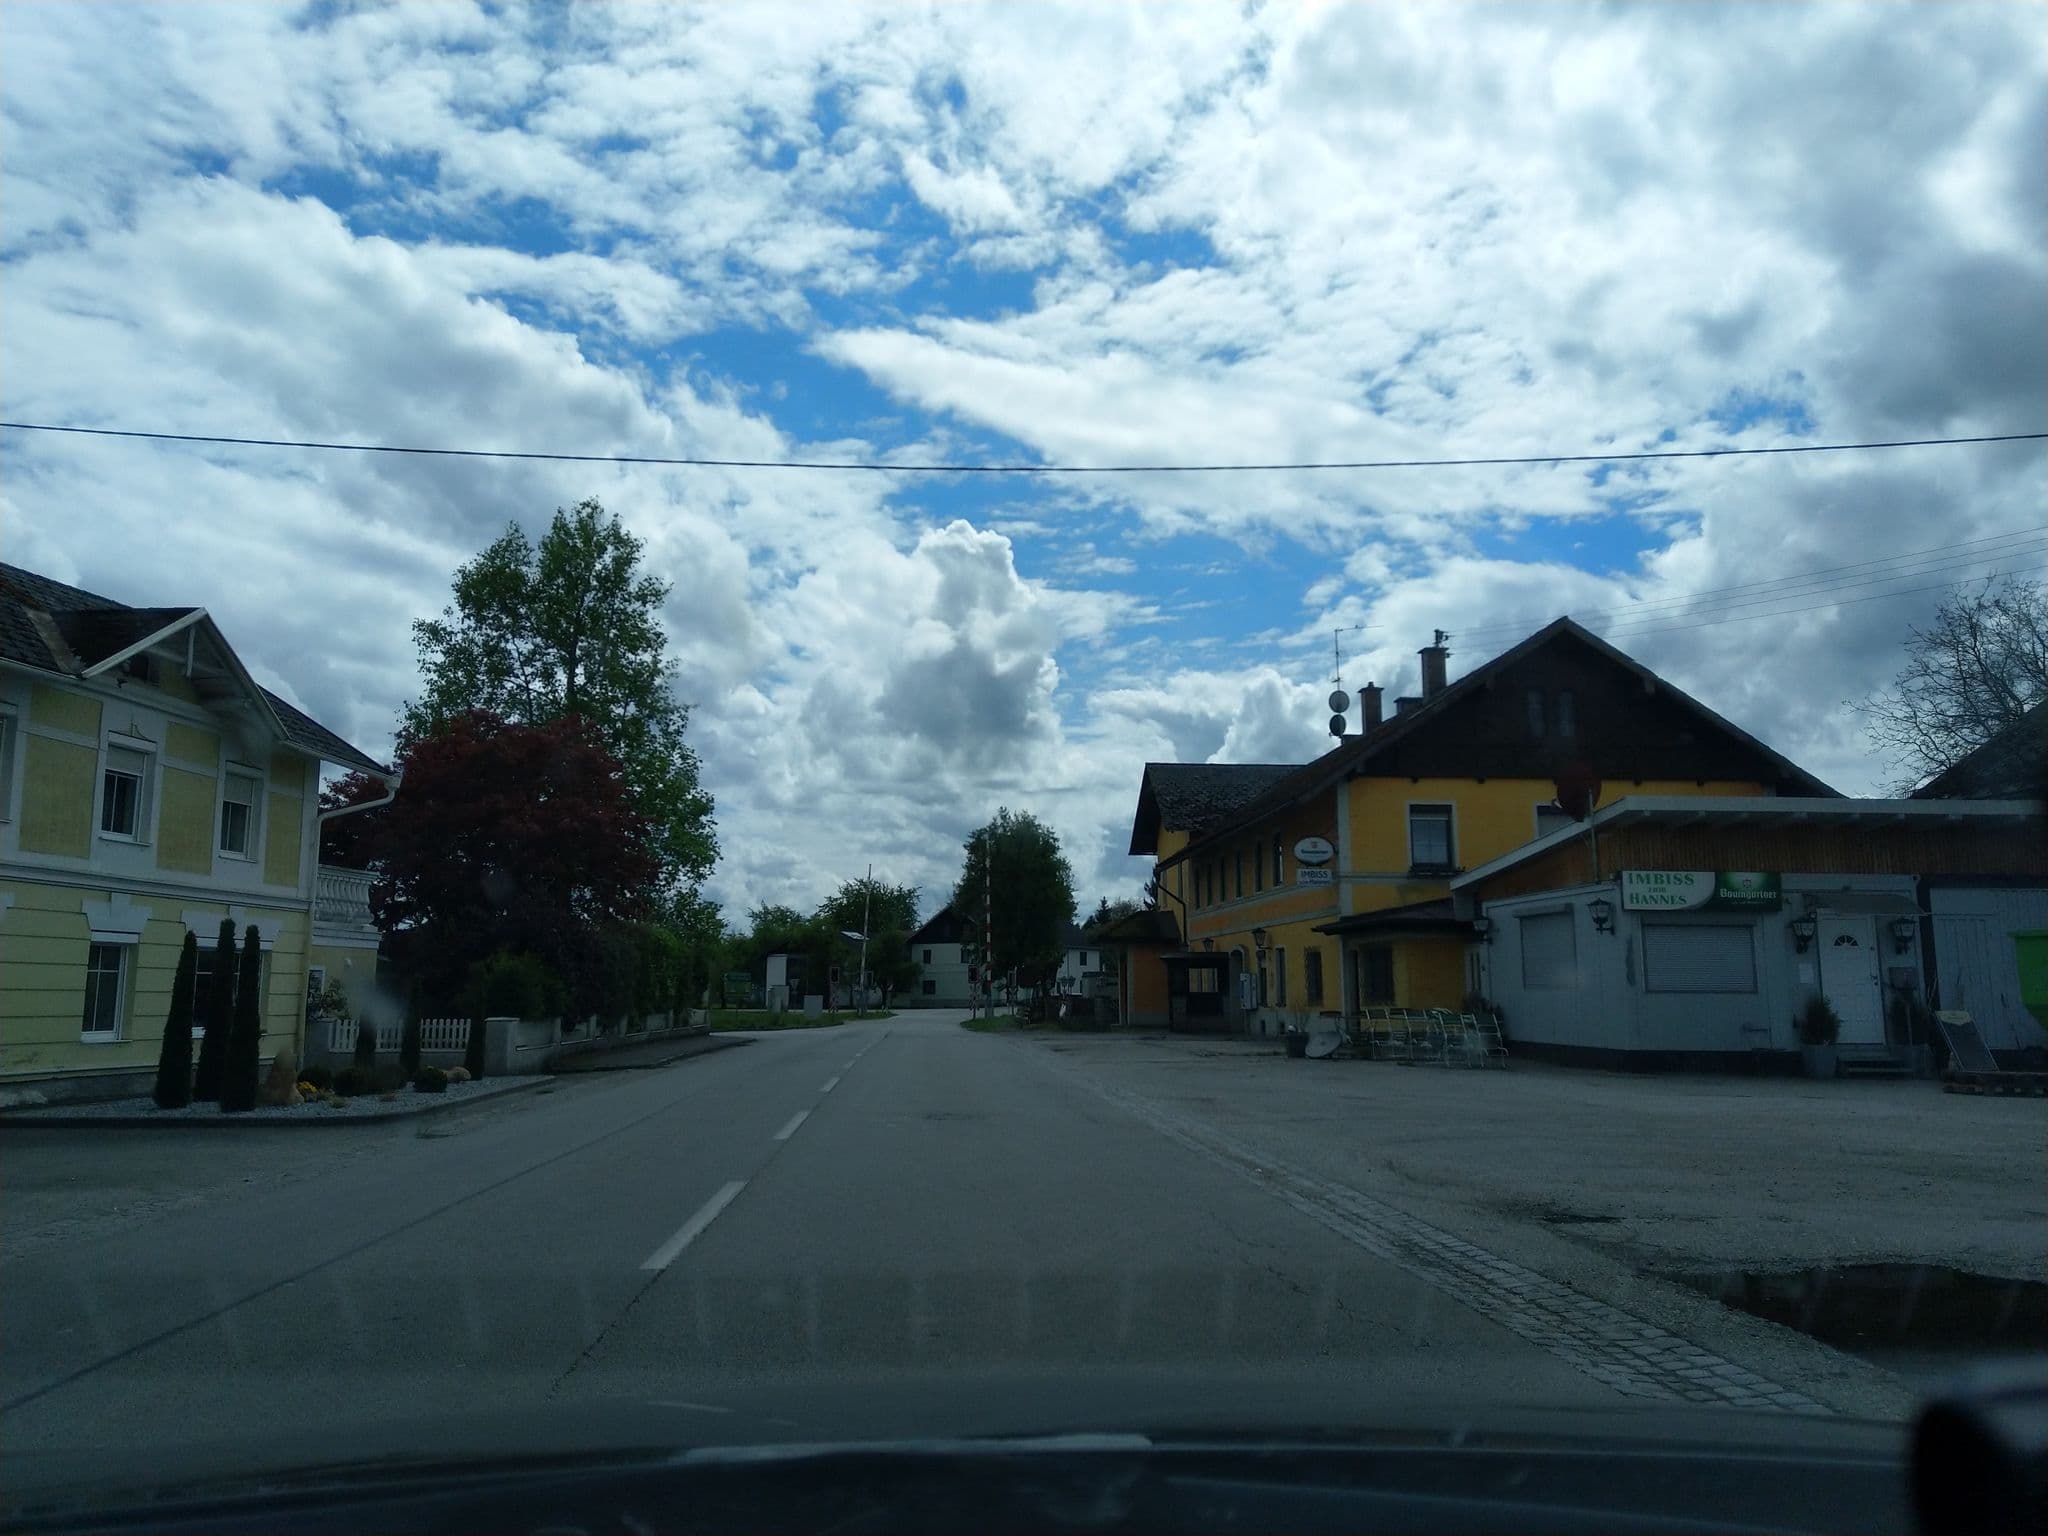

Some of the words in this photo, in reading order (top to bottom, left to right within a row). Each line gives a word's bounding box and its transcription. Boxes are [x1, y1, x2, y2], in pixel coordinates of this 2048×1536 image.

[1301, 870, 1328, 878] IMBISS
[1628, 872, 1694, 886] IMBISS
[1630, 893, 1687, 905] HANNES
